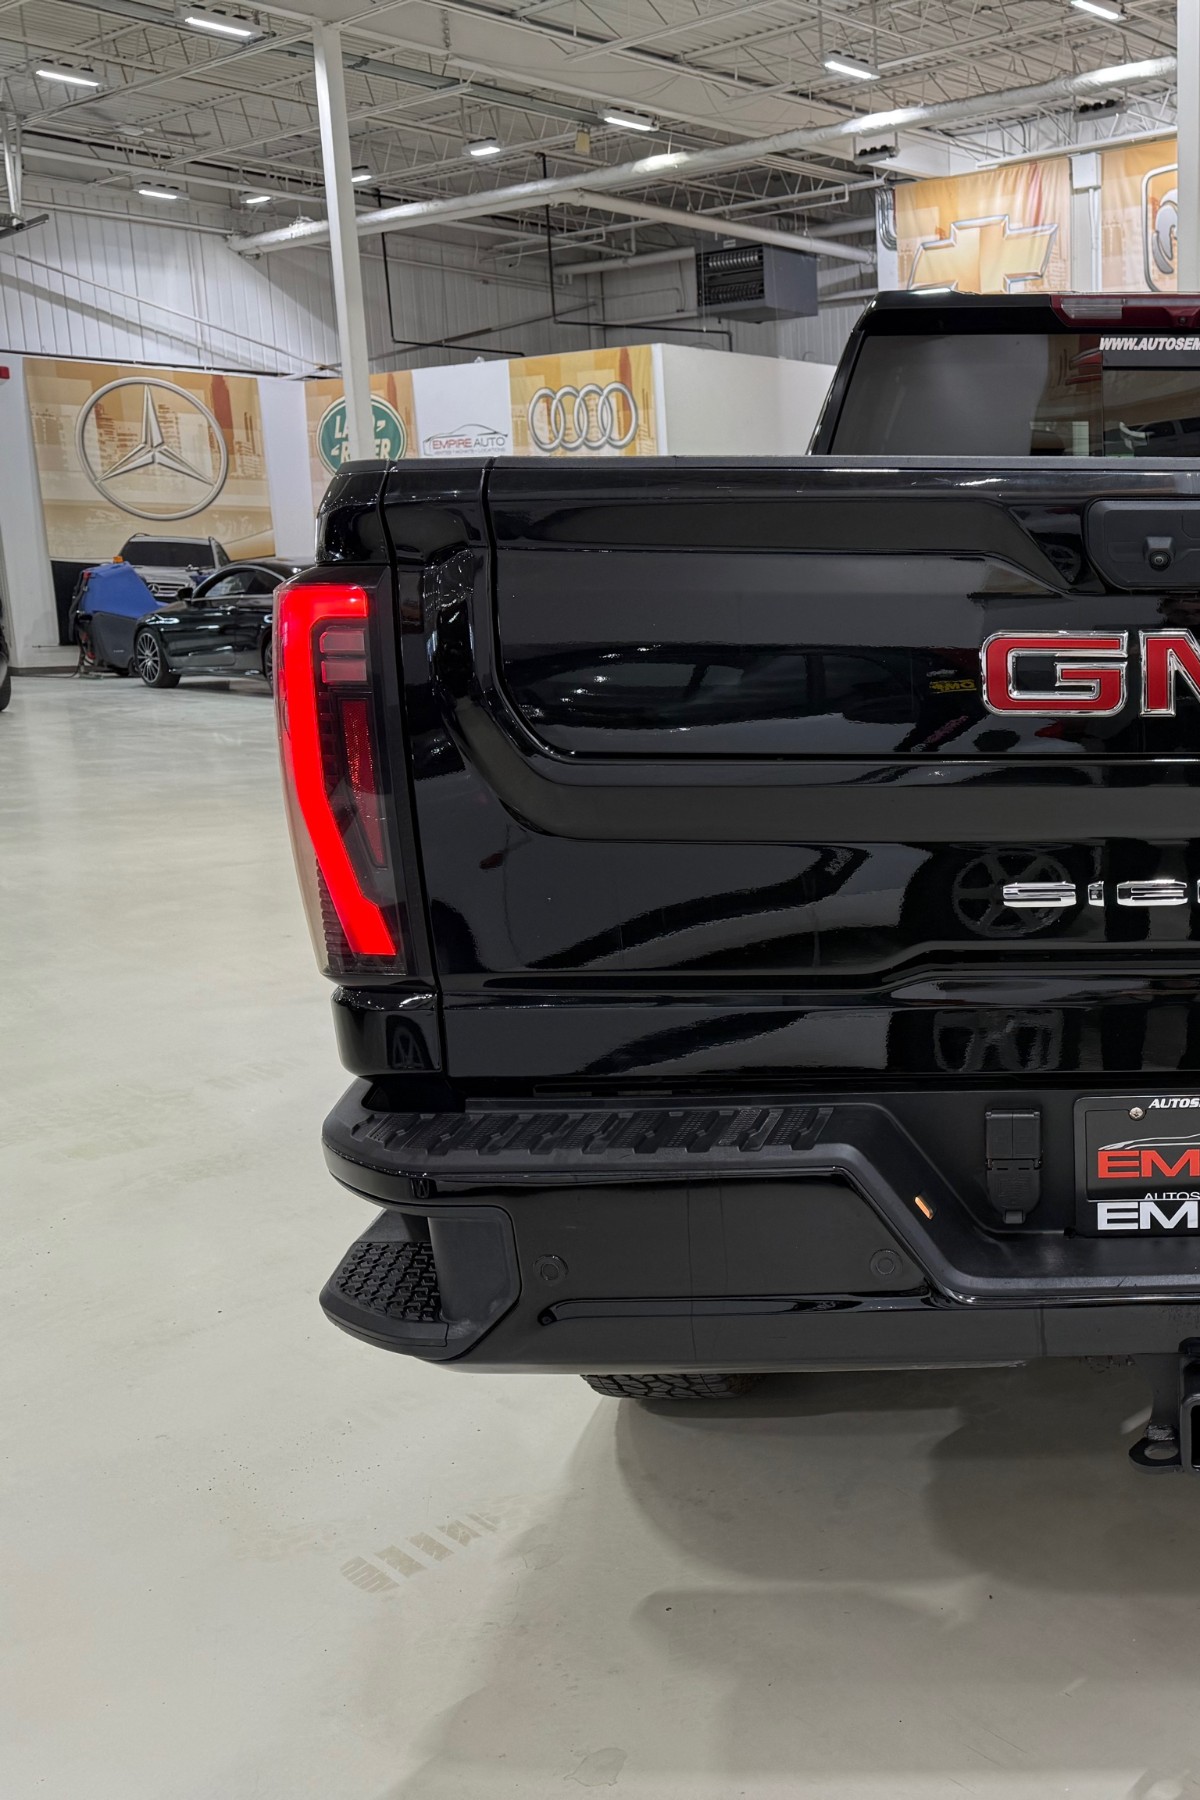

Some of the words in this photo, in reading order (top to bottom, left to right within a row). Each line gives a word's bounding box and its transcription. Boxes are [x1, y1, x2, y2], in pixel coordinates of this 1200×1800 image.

[340, 438, 391, 464] RER
[432, 438, 472, 450] EMPIRE
[473, 436, 506, 448] AUTO
